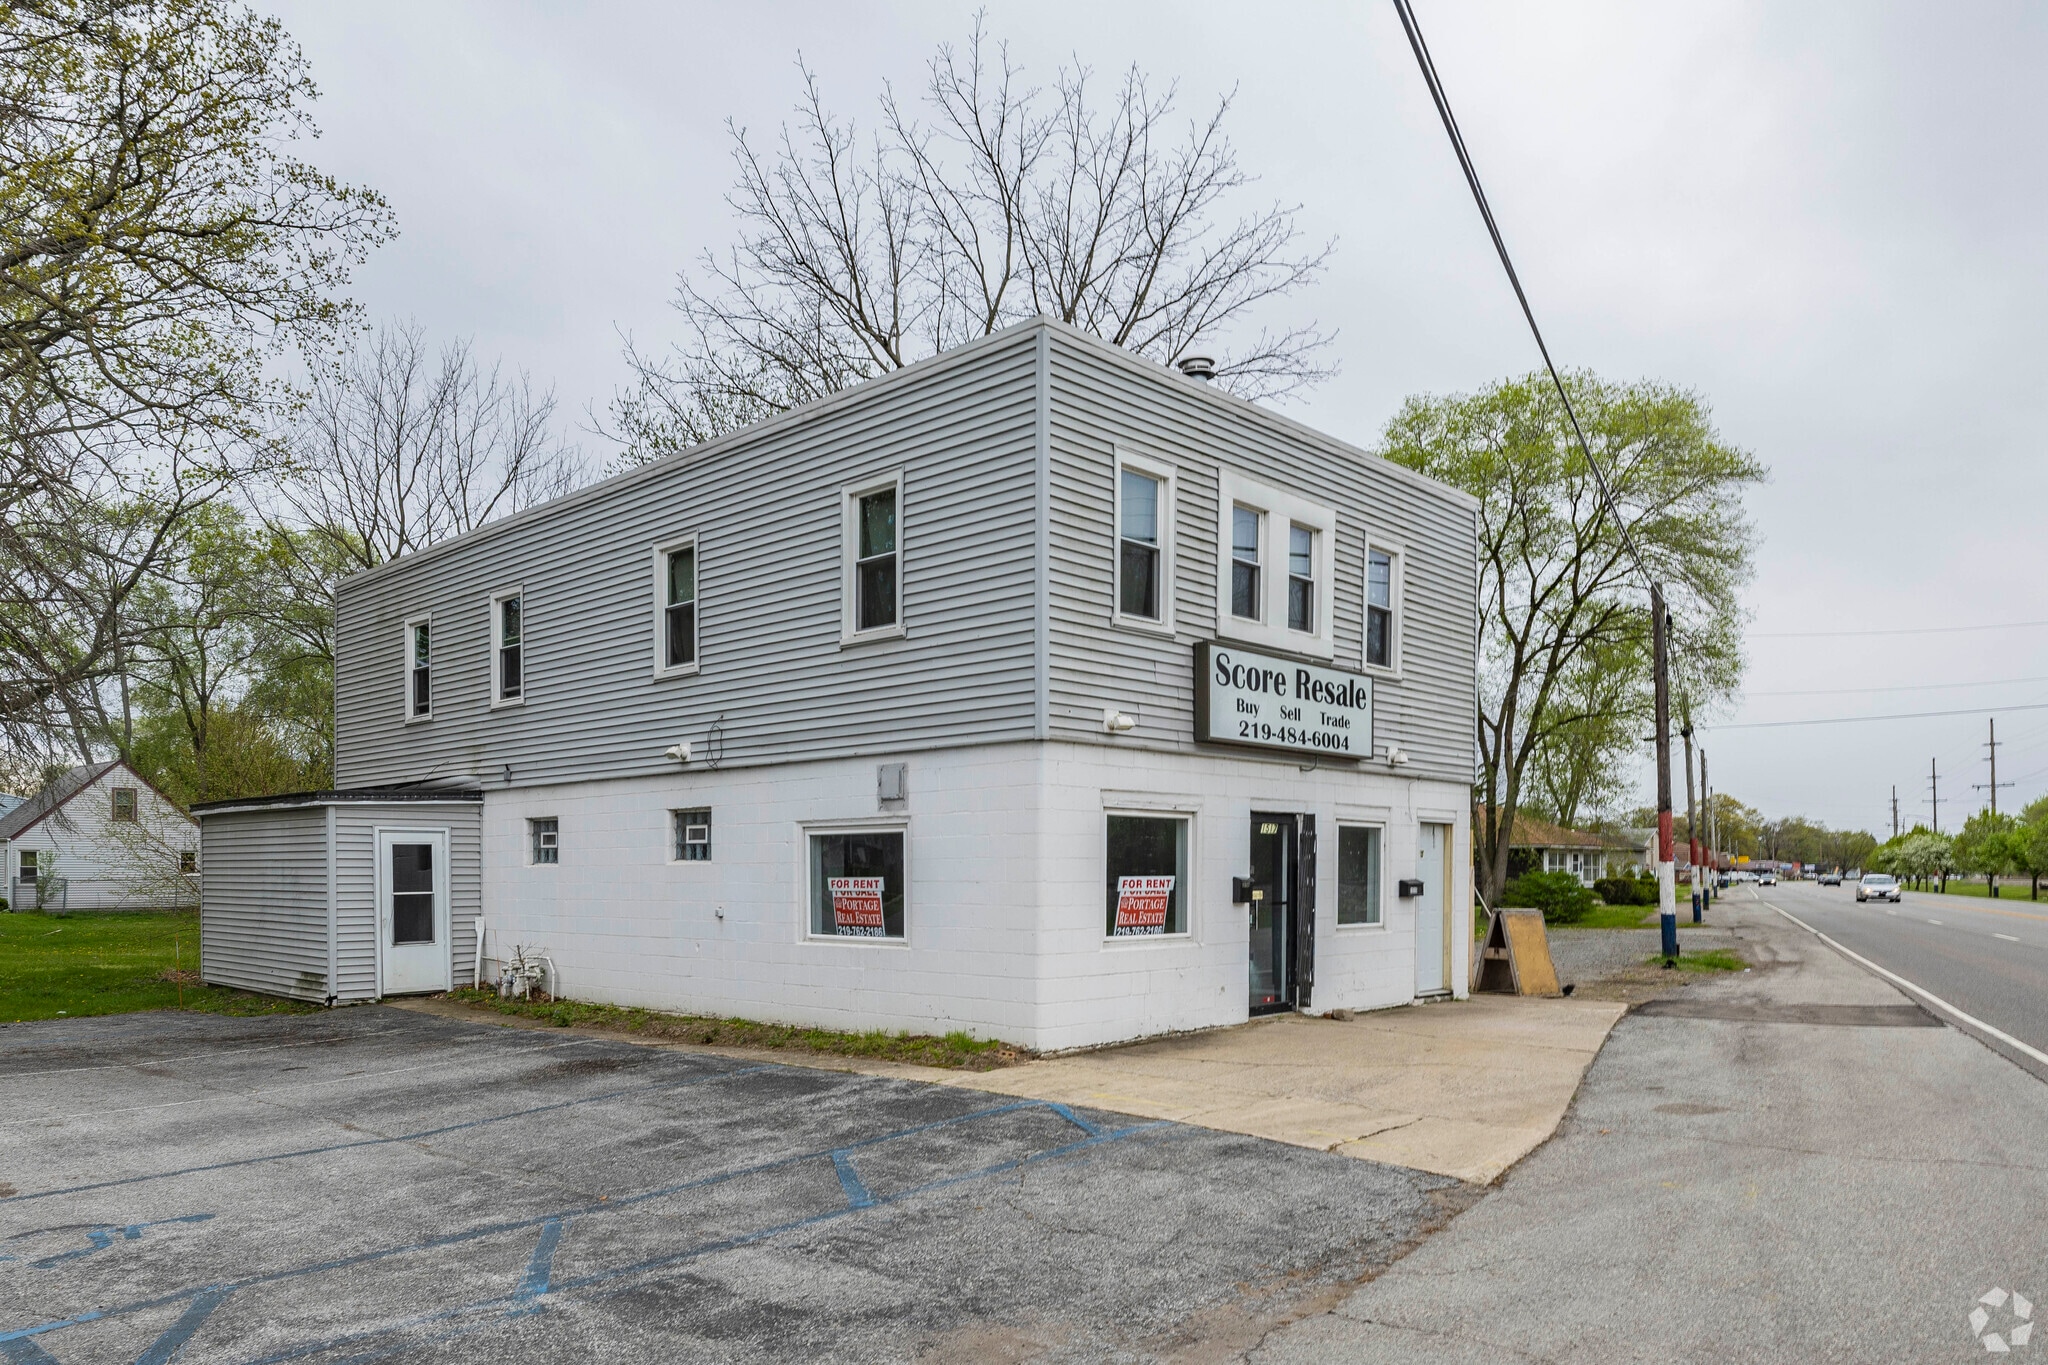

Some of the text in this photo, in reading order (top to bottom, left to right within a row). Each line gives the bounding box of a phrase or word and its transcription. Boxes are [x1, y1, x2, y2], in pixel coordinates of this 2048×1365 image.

[1215, 652, 1367, 710] Score Resale
[1236, 698, 1351, 729] Buy Sell Trade
[1239, 720, 1350, 751] 219-484-6004
[831, 879, 879, 889] FOR RENT
[1122, 879, 1171, 888] FOR RENT
[842, 898, 879, 910] PORTAGE
[1127, 898, 1165, 910] PORTAGE
[837, 911, 881, 924] REAL ESTATE
[1119, 911, 1163, 924] REAL ESTATE
